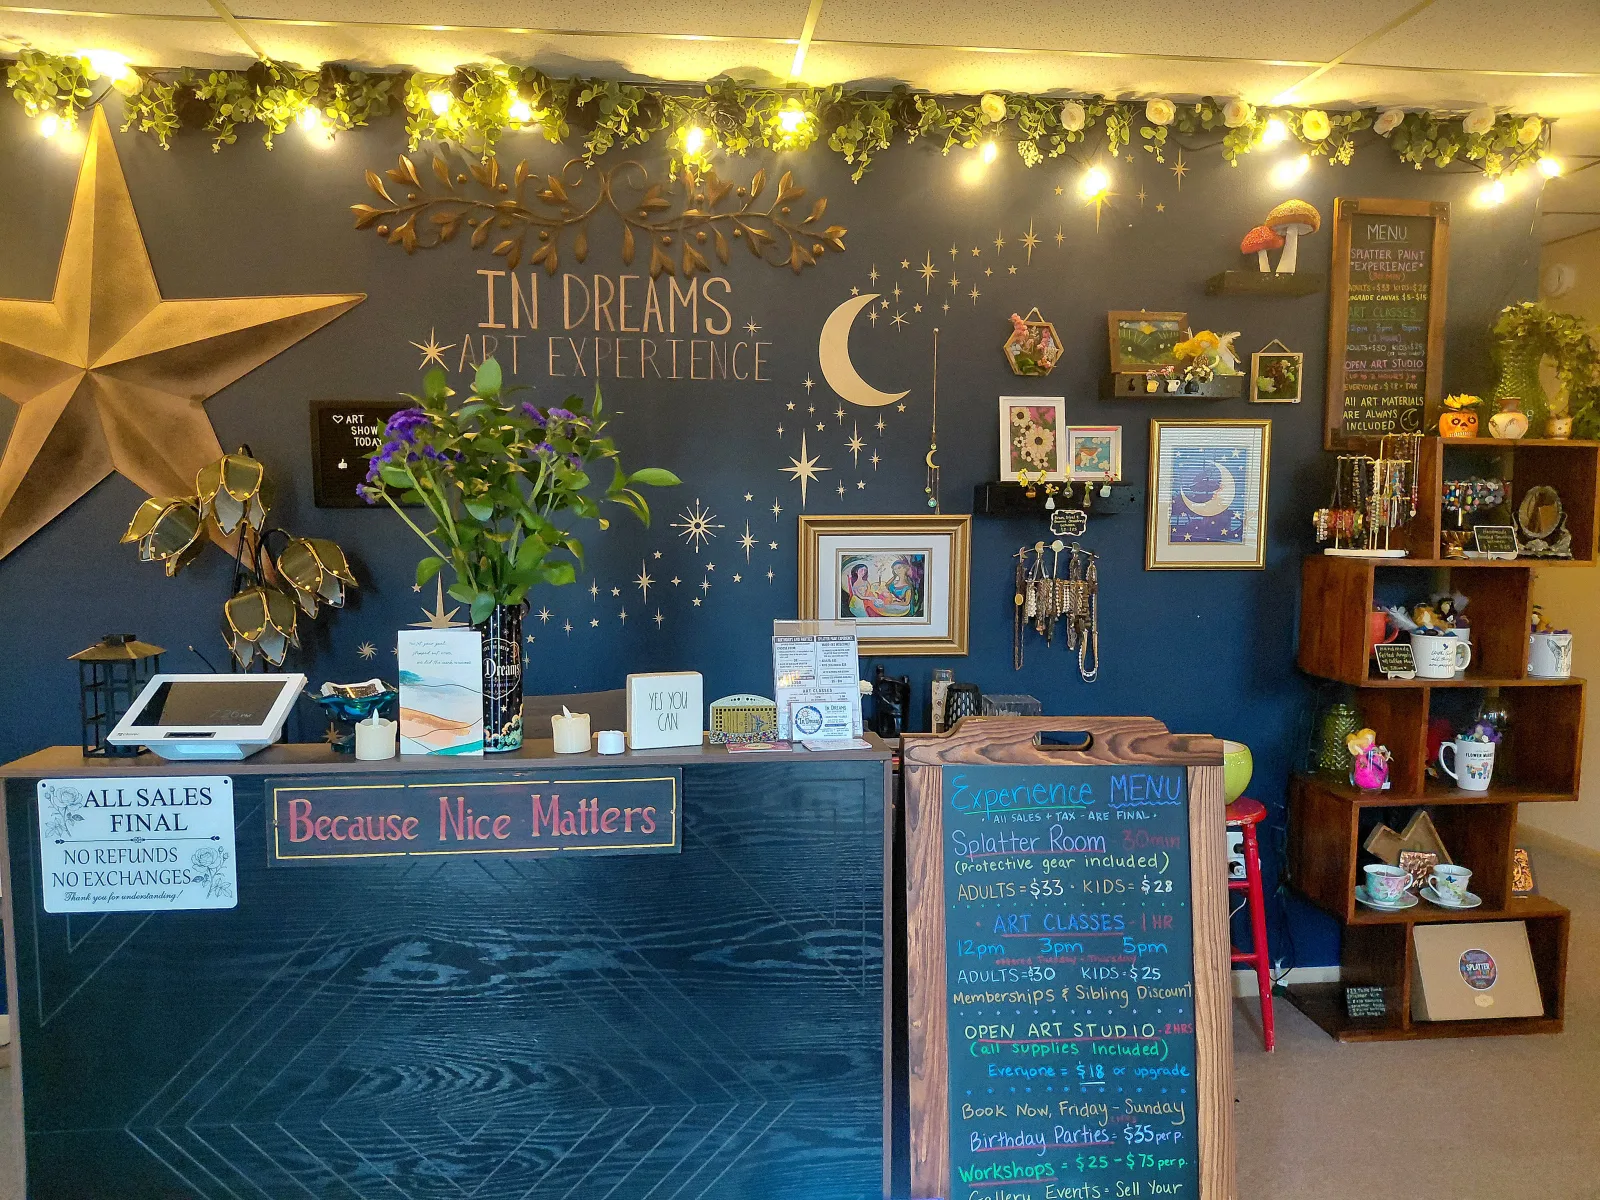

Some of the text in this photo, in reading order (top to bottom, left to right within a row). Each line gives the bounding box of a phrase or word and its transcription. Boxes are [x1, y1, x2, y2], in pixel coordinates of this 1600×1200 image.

[1367, 224, 1407, 240] MENU
[1351, 249, 1425, 260] SPLATTER PAINT
[476, 269, 732, 335] IN DREAMS
[1373, 306, 1417, 318] CLASSES
[459, 333, 773, 381] ART EXPERIENCE
[1345, 358, 1424, 370] OPEN ART STUDIO
[1405, 382, 1418, 390] TAX
[1361, 397, 1378, 407] ART
[1381, 396, 1424, 407] MATERIALS
[346, 414, 364, 424] ART
[1343, 409, 1398, 419] ARE ALWAYS
[351, 426, 378, 436] SHOW
[1346, 420, 1396, 431] INCLUDED
[354, 437, 382, 447] TODAY
[483, 658, 521, 679] Dreams
[648, 690, 688, 712] YES YOU
[657, 712, 679, 732] CAN
[83, 787, 213, 808] ALL SALES
[951, 773, 1181, 821] Experience MENU
[110, 813, 188, 833] FINAL
[287, 793, 657, 843] Because Nice Matters
[1011, 812, 1041, 823] SALES
[1055, 811, 1076, 822] TAX
[1087, 811, 1110, 821] ARE
[1116, 810, 1150, 820] FINAL
[951, 829, 1041, 861] Splatter
[1050, 824, 1106, 853] Room
[63, 847, 178, 865] NO REFUNDS
[1042, 857, 1076, 874] gear
[1084, 851, 1170, 875] included)
[52, 868, 191, 888] NO EXCHANGES
[957, 881, 1016, 901] ADULTS
[1029, 877, 1065, 900] $33
[1140, 874, 1173, 896] $28
[63, 890, 184, 905] Thank you for understanding!
[993, 914, 1032, 934] ART
[1043, 913, 1126, 932] CLASSES
[957, 936, 1168, 958] 12pm 3pm 5pm
[1081, 966, 1119, 980] KIDS
[1129, 963, 1162, 983] $25
[1465, 962, 1491, 972] SPLATTER
[953, 989, 1056, 1005] Memberships
[1075, 984, 1129, 1009] Sibling
[1137, 981, 1193, 1000] Discount
[964, 1023, 1015, 1040] OPEN
[1028, 1022, 1063, 1039] ART
[1073, 1022, 1155, 1039] STUDIO
[969, 1041, 1000, 1057] (all
[1012, 1041, 1080, 1058] supplies
[988, 1064, 1056, 1080] Everyone
[1076, 1060, 1105, 1080] $18
[1112, 1067, 1126, 1076] or
[1134, 1064, 1190, 1081] upgrade
[961, 1103, 1008, 1120] Book
[1058, 1100, 1108, 1127] Friday
[1125, 1098, 1186, 1126] Sunday
[970, 1131, 1047, 1157] Birthday
[1123, 1122, 1155, 1145] $35
[958, 1160, 1055, 1183] Workshops
[1075, 1153, 1109, 1172] $25
[1126, 1153, 1155, 1172] $75
[1045, 1184, 1101, 1200] Events
[1115, 1181, 1140, 1198] Sell
[1148, 1181, 1183, 1196] Your
